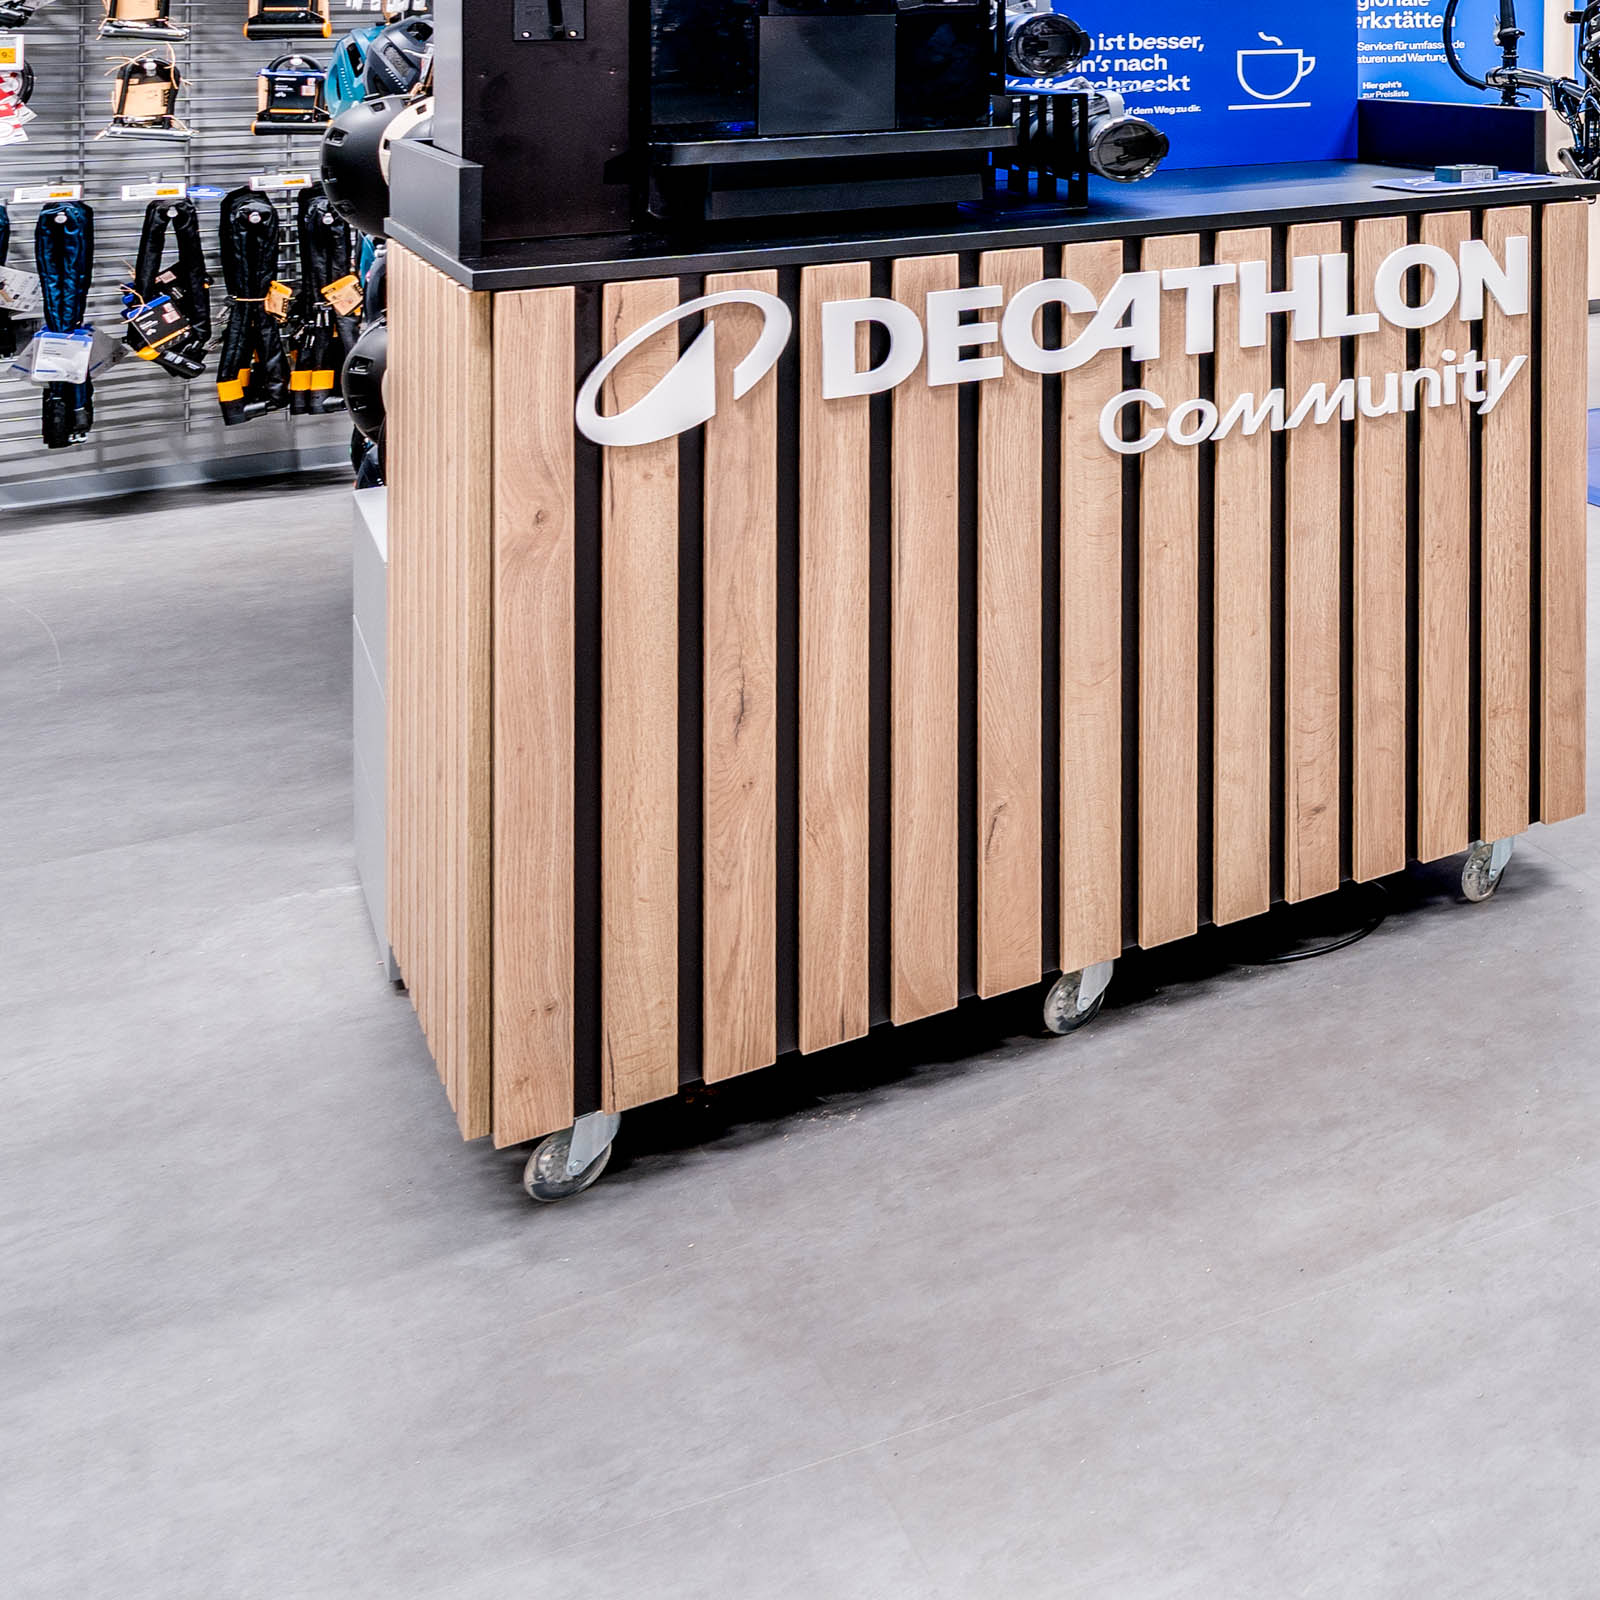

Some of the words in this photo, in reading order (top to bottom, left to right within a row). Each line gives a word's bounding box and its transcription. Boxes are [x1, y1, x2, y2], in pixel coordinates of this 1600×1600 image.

[1098, 32, 1126, 51] ist
[1129, 31, 1205, 53] besser,
[1357, 41, 1393, 51] Service
[1394, 41, 1408, 50] für
[1114, 54, 1168, 72] nach
[1387, 54, 1407, 63] und
[1362, 81, 1379, 90] Hier
[1375, 90, 1410, 99] Preisliste
[1133, 105, 1153, 115] dem
[1153, 105, 1175, 117] Weg
[1176, 106, 1188, 114] zu
[822, 236, 1530, 401] DECATHLON
[1100, 349, 1529, 455] Community
